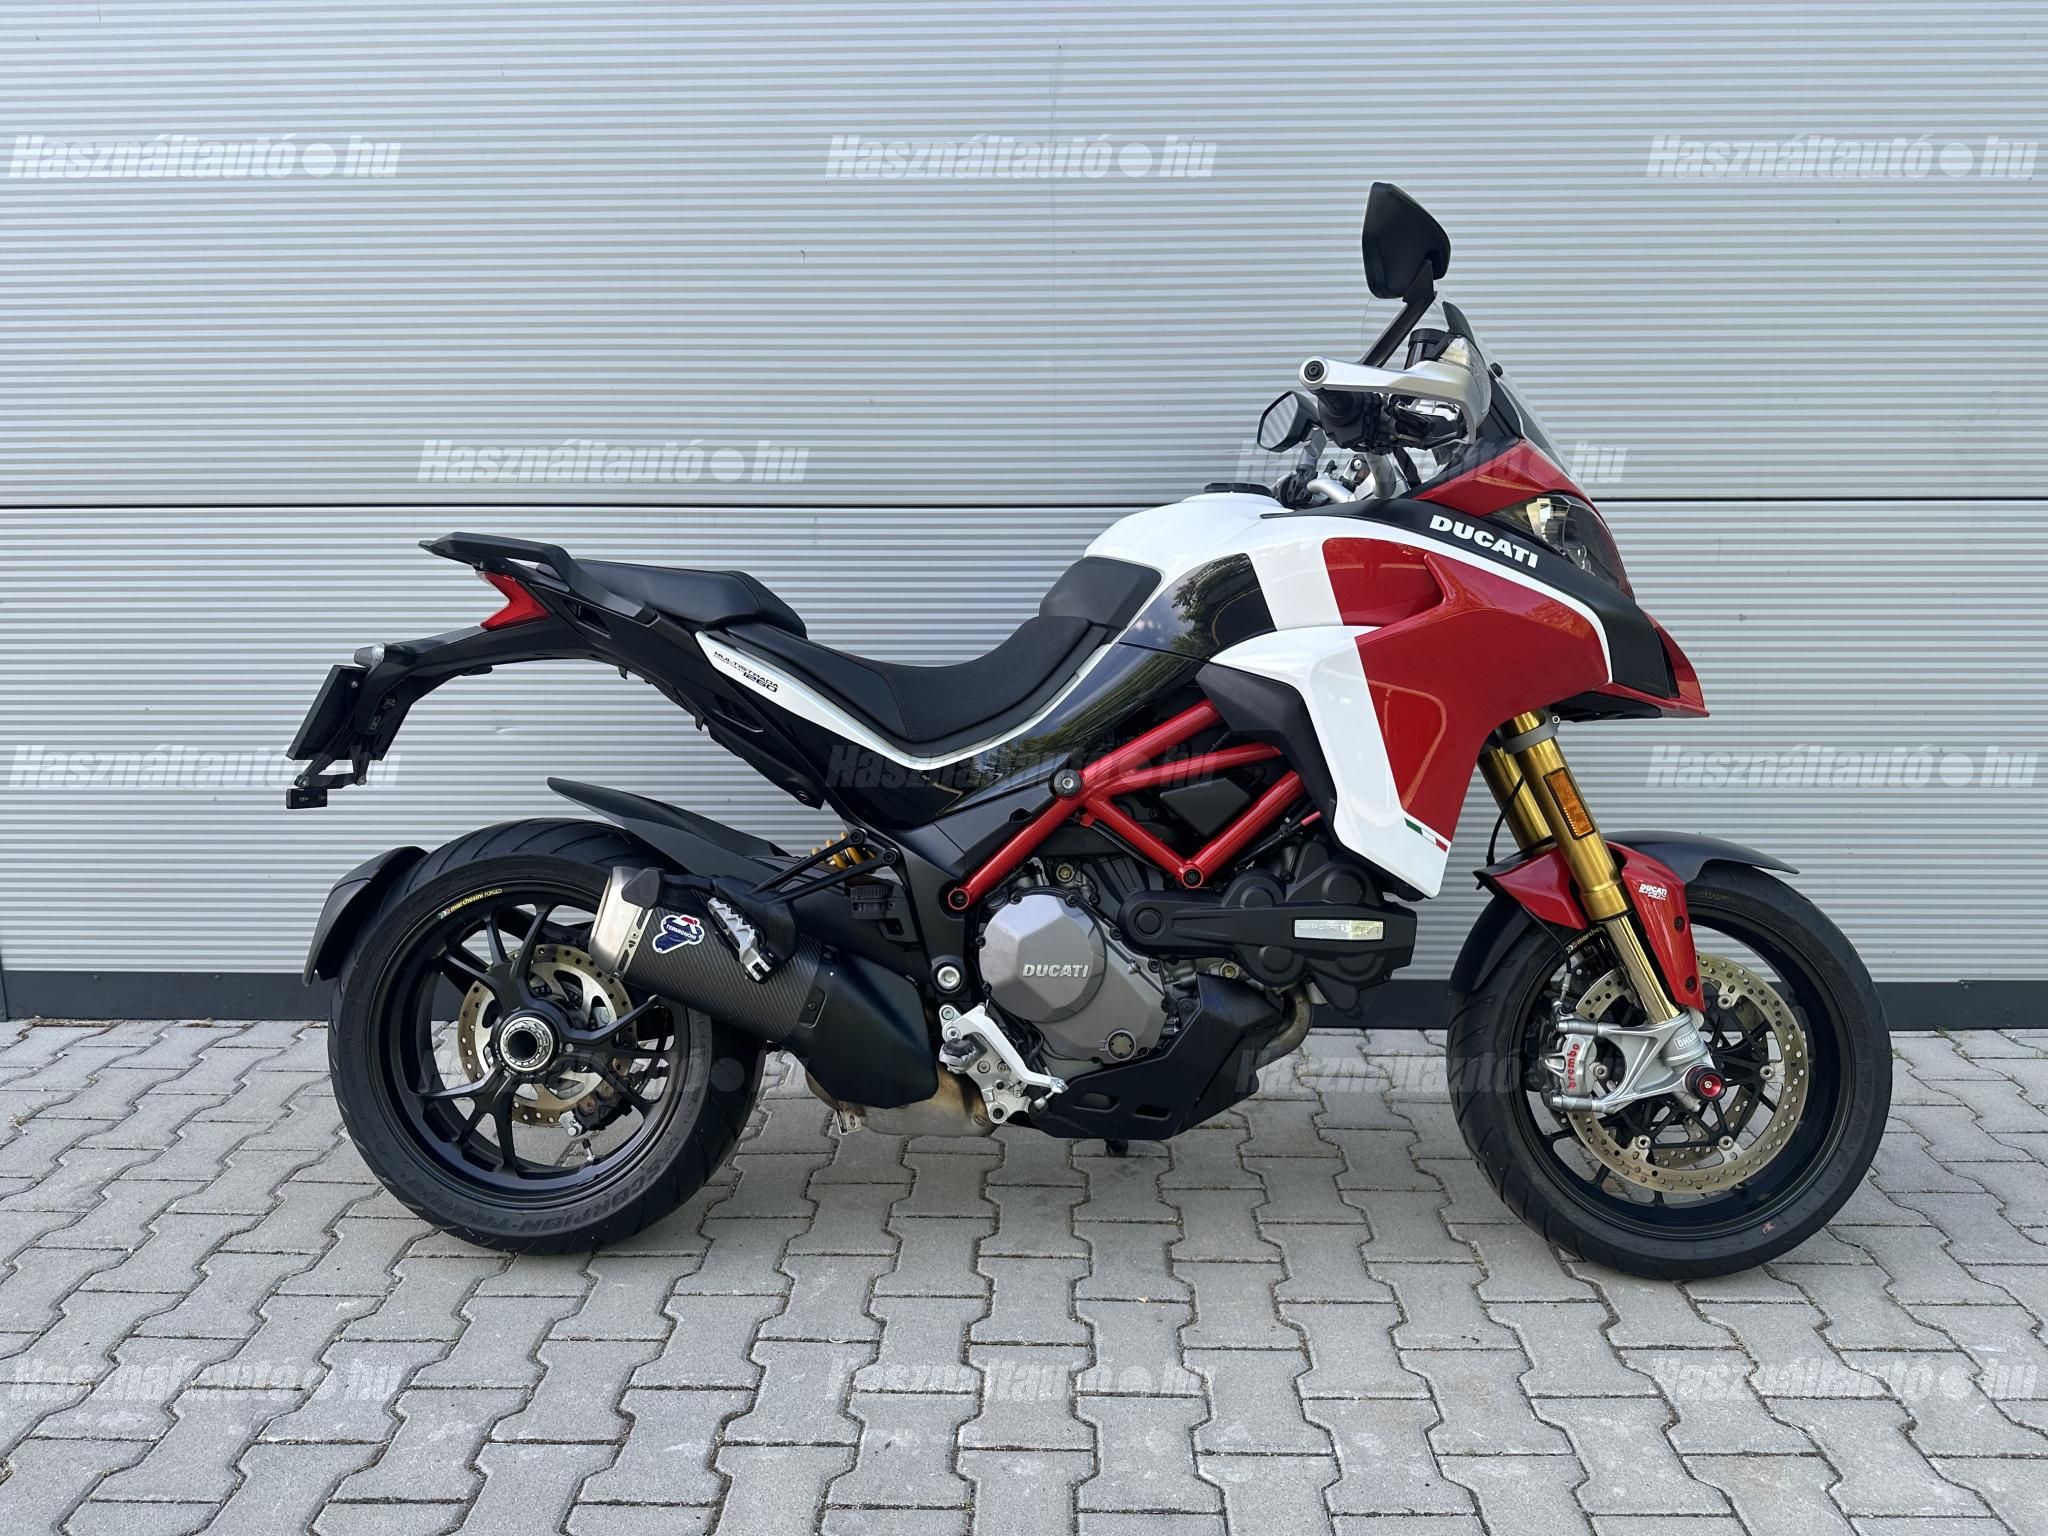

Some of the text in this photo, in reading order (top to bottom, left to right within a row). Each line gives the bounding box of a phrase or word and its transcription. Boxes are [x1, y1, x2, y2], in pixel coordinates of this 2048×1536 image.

[1429, 514, 1539, 569] DUCATI
[714, 651, 779, 688] MULTISTRADA
[1022, 963, 1089, 978] DUCATI
[1567, 1043, 1580, 1089] brembo
